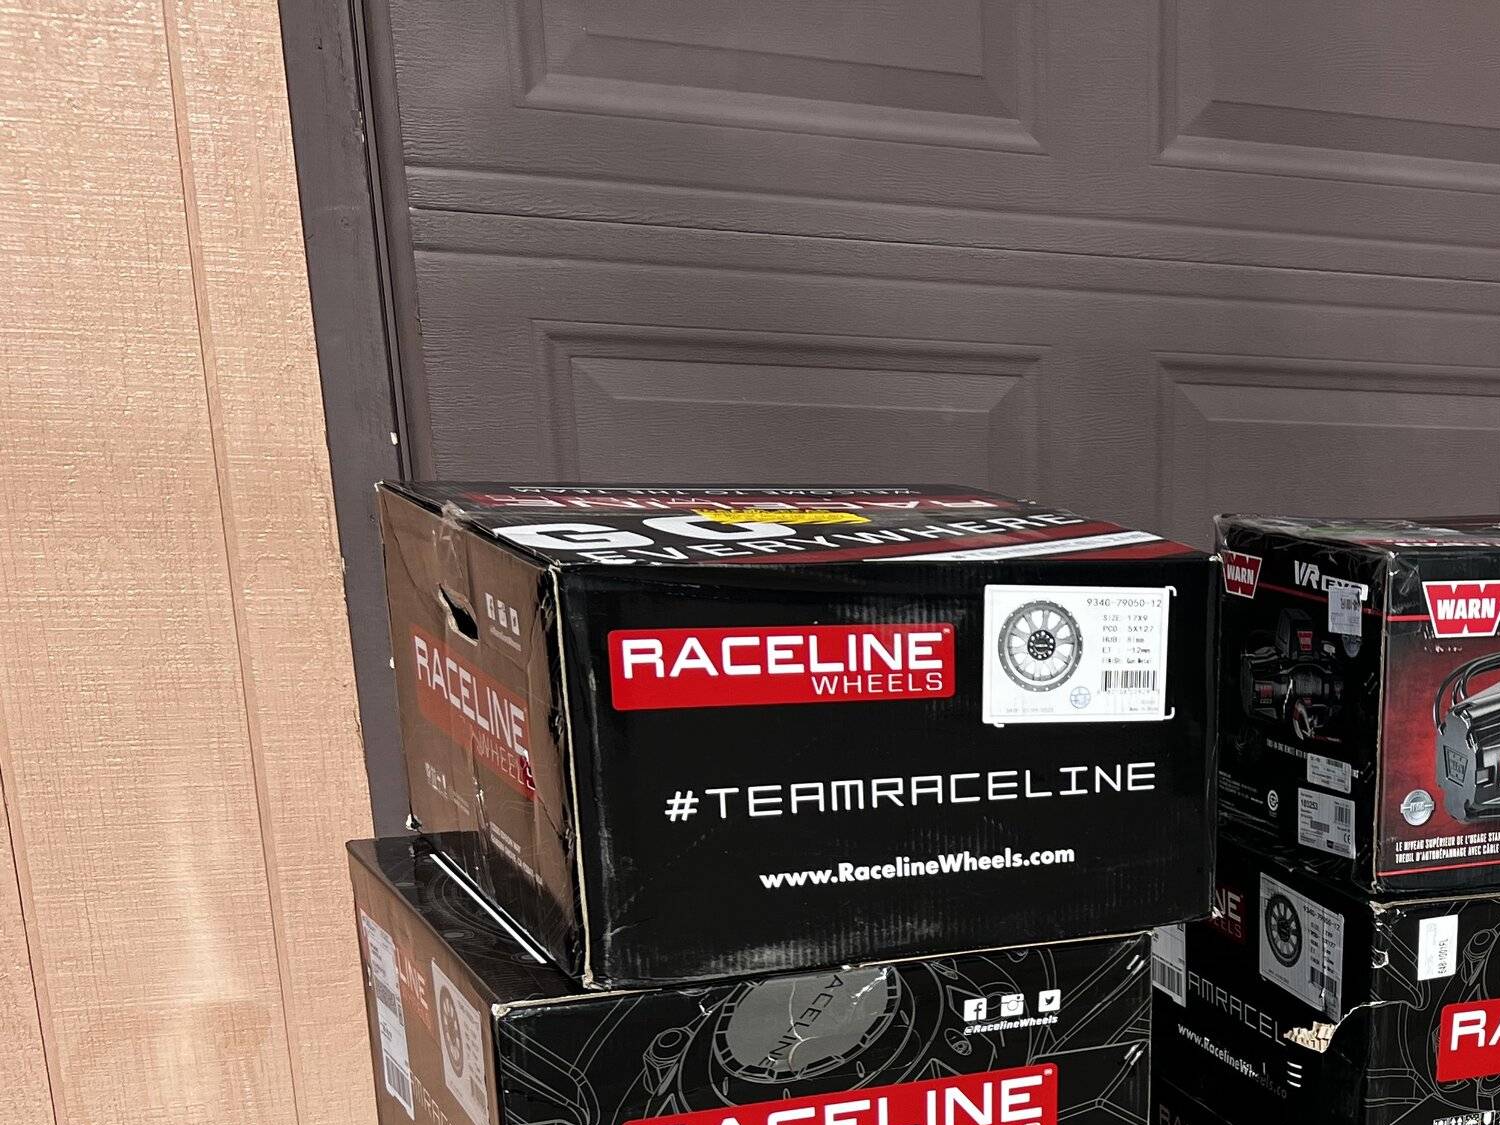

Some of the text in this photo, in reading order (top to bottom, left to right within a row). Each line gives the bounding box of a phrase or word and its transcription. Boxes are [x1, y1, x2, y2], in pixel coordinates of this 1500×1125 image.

[577, 514, 1084, 565] EVERYWHERE
[1227, 564, 1254, 586] WARN
[1294, 560, 1320, 589] VR
[1437, 598, 1497, 620] WARN
[622, 632, 943, 679] RACELINE
[414, 635, 529, 758] RACELINE
[811, 672, 944, 696] WHEELS
[665, 761, 1157, 822] #TEAMRACELINE
[760, 847, 1075, 888] www.RacelineWheels.com
[758, 974, 844, 1068] ACELINE
[963, 1015, 1059, 1036] @RacelineWheels
